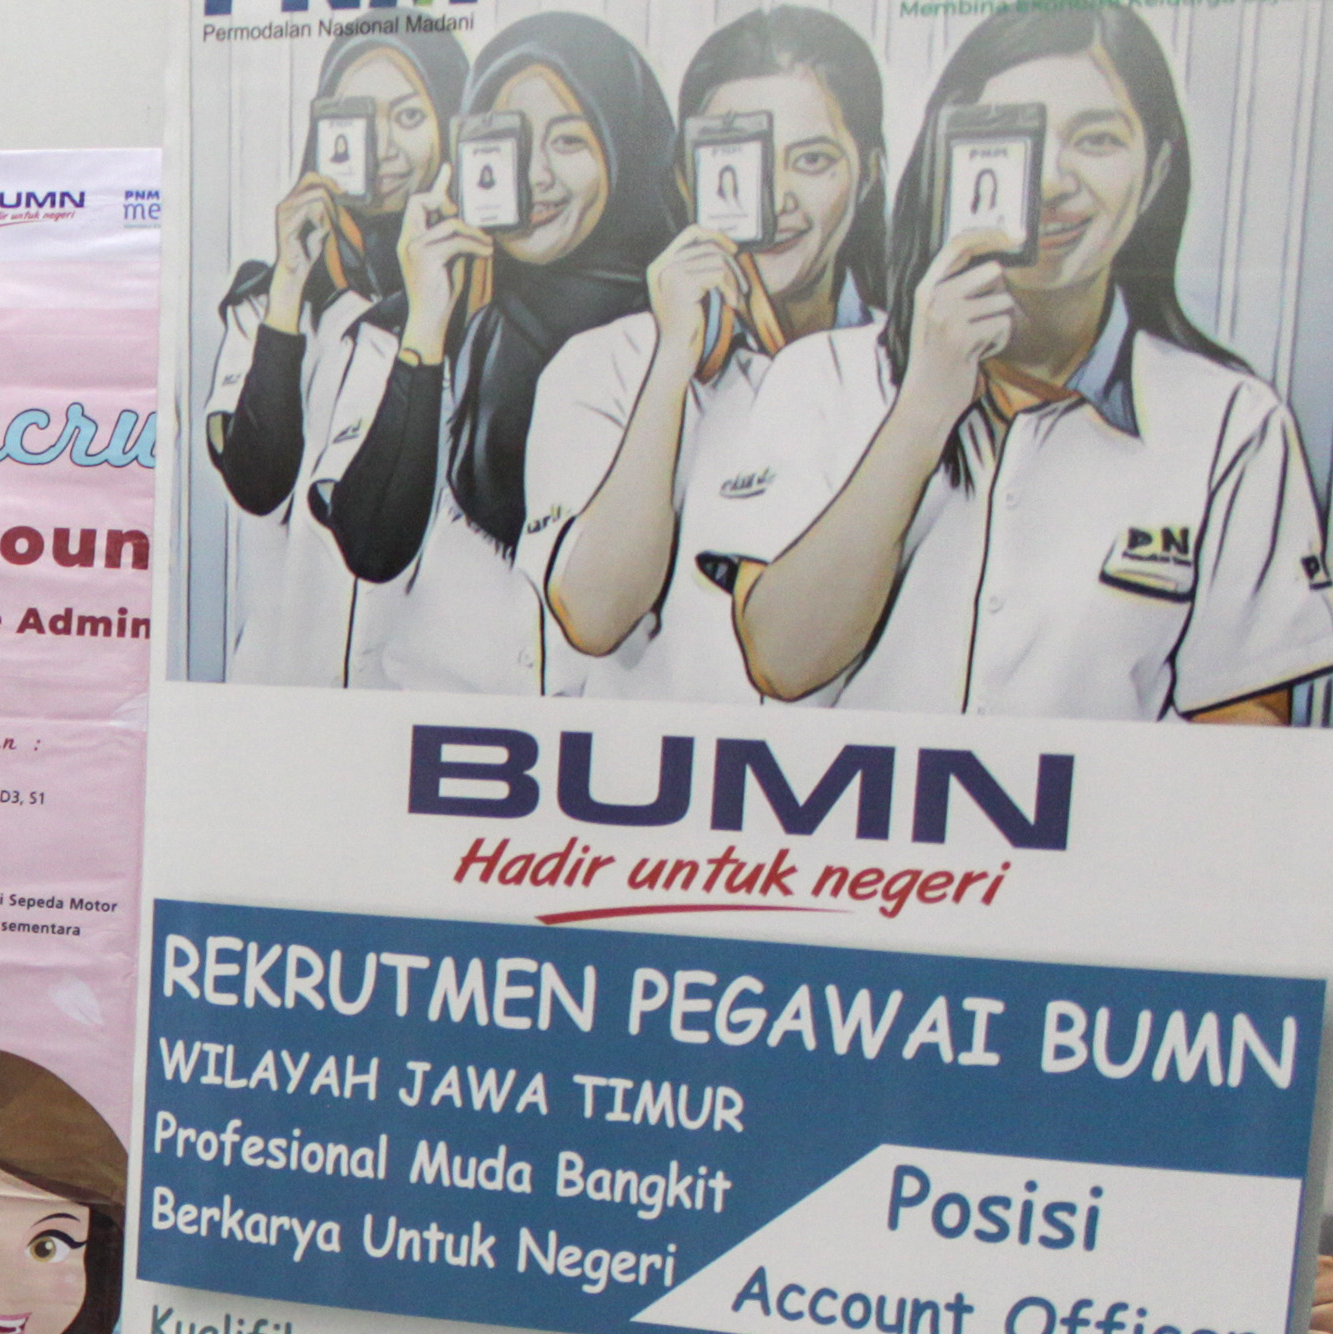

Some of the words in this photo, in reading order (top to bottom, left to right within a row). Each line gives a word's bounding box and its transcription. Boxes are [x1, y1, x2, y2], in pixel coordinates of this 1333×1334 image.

[203, 16, 311, 42] Permodalan
[318, 16, 399, 36] Nasional
[405, 12, 474, 34] Madani
[125, 190, 160, 200] PNM
[17, 608, 150, 640] Admin
[407, 724, 1074, 851] BUMN
[10, 894, 64, 910] Sepeda
[70, 898, 117, 912] Motor
[454, 837, 617, 888] Hadir
[627, 846, 798, 898] untuk
[813, 862, 1011, 919] negeri
[1, 922, 80, 936] sementara
[163, 932, 599, 1034] REKRUTMEN
[629, 968, 1005, 1069] PEGAWAI
[1042, 998, 1298, 1092] BUMN
[160, 1037, 379, 1101] WILAYAH
[398, 1060, 552, 1118] JAWA
[574, 1074, 746, 1135] TIMUR
[153, 1112, 388, 1183] Profesional
[409, 1139, 532, 1196] Muda
[554, 1152, 734, 1220] Bangkit
[887, 1163, 1106, 1255] Posisi
[151, 1187, 342, 1259] Berkarya
[363, 1217, 497, 1269] Untuk
[517, 1229, 678, 1297] Negeri
